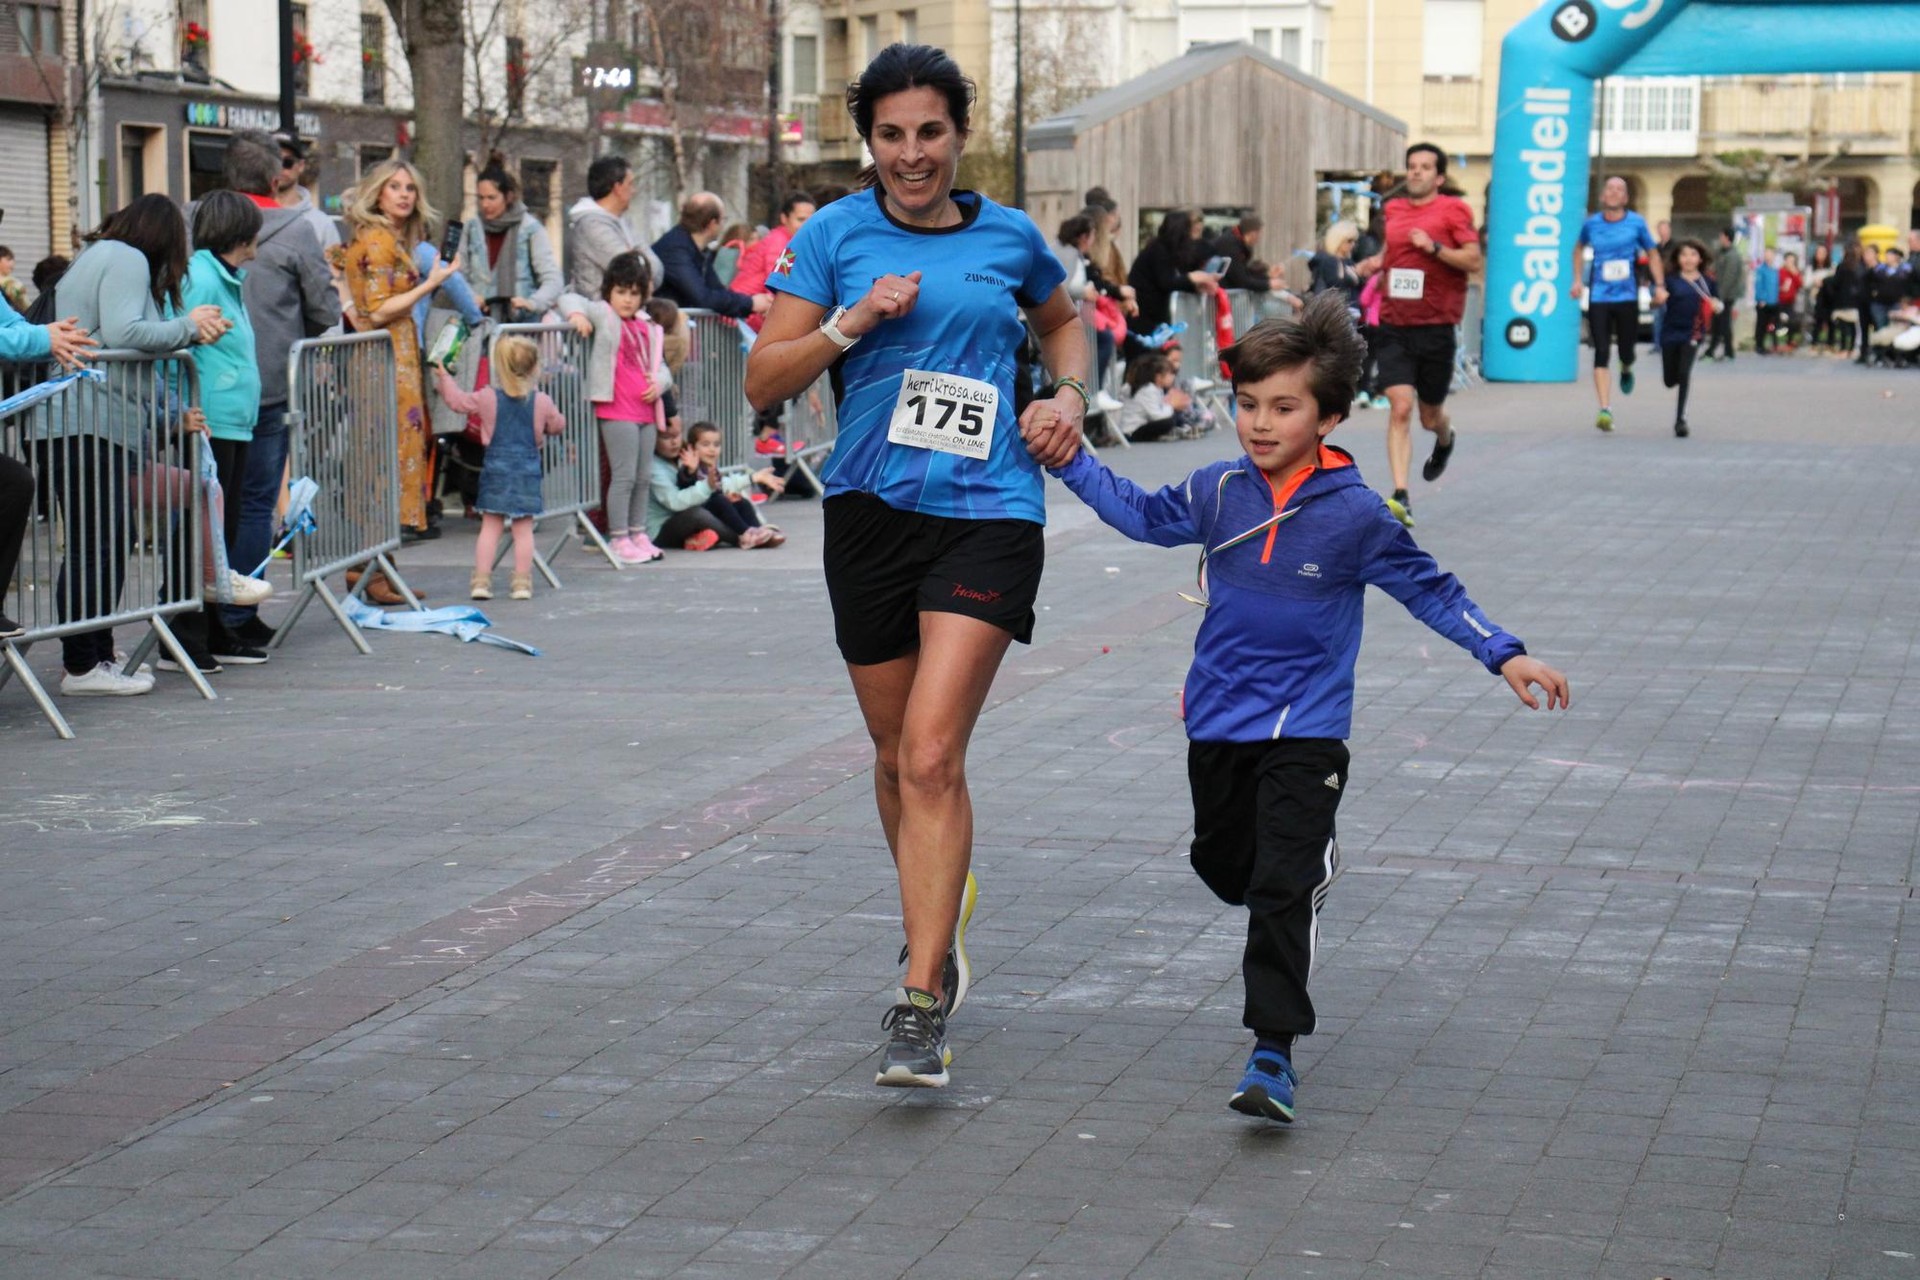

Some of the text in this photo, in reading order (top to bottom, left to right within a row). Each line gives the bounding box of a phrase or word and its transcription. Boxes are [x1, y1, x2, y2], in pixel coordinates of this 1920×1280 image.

[1556, 5, 1589, 37] B
[1510, 88, 1571, 342] B Sabadell
[1393, 278, 1420, 290] 230
[906, 374, 994, 404] herrikrosa.eus
[906, 394, 985, 436] 175
[952, 436, 966, 445] ON
[967, 438, 987, 449] LINE
